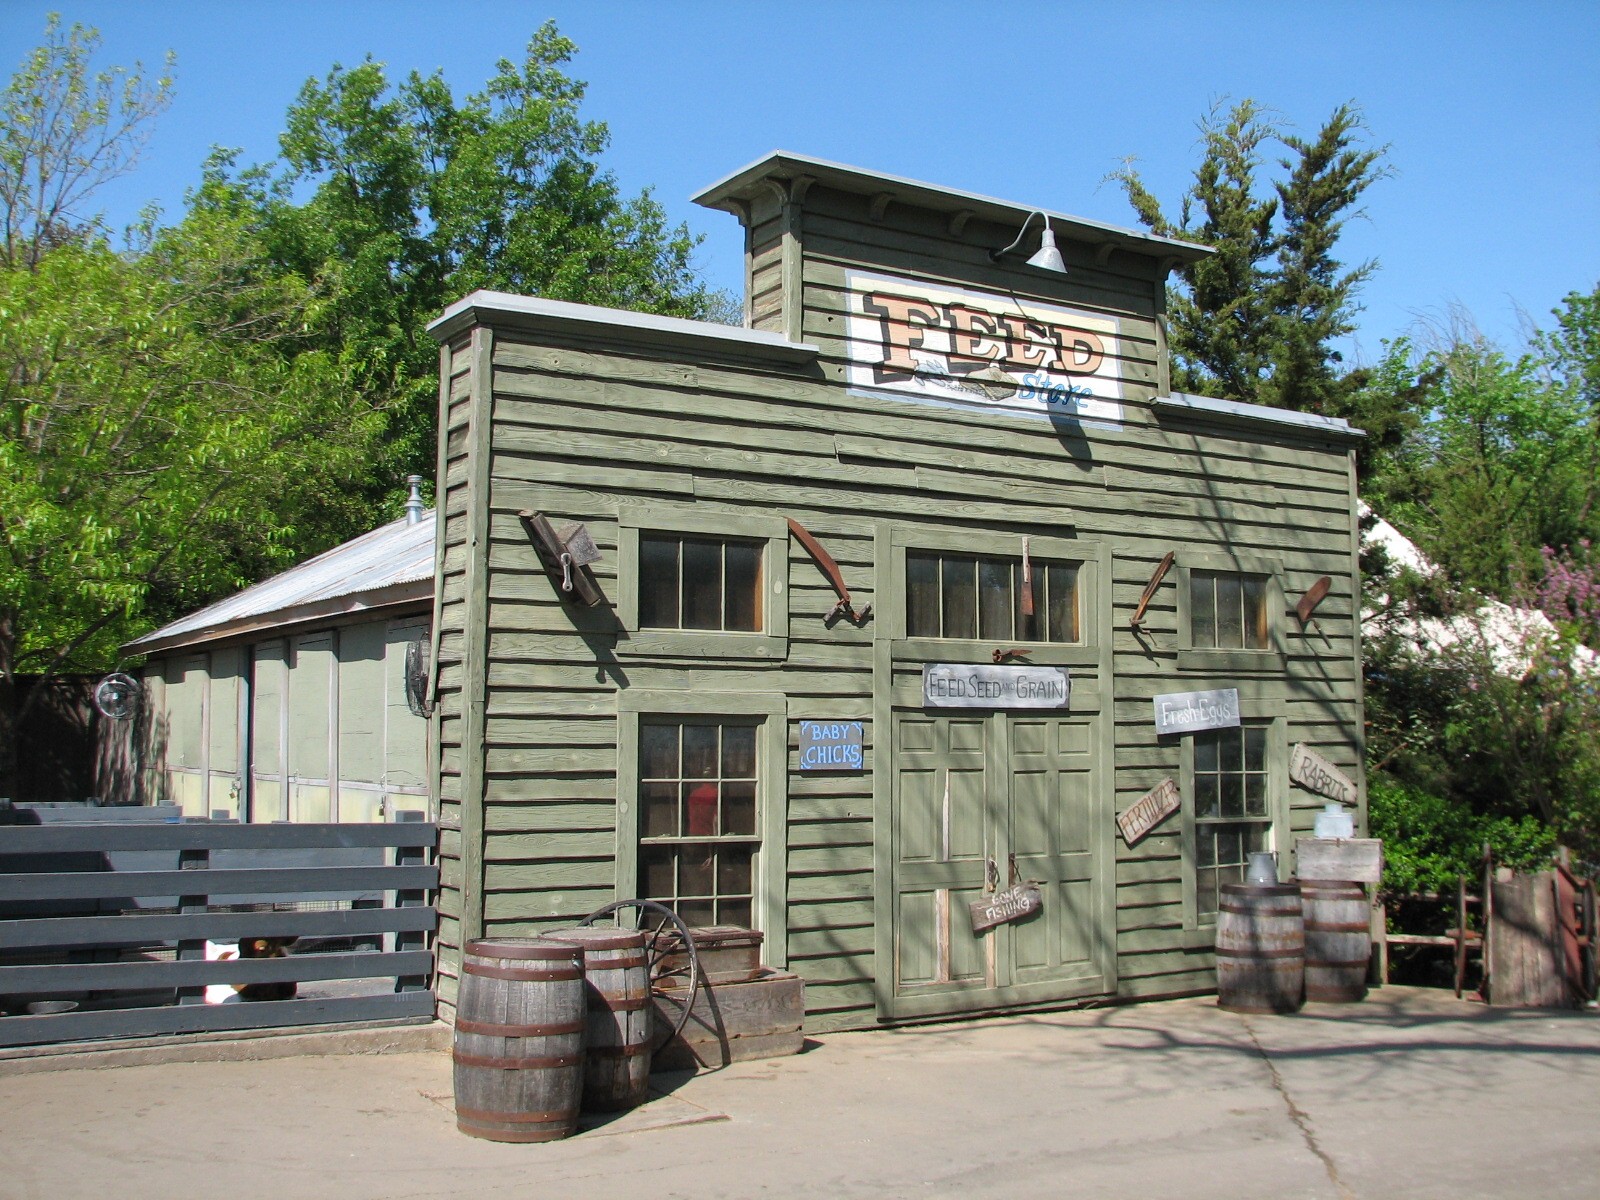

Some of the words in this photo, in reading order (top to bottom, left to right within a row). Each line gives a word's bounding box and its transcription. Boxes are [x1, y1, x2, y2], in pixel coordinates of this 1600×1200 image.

[863, 291, 1105, 384] FEED
[1018, 373, 1093, 409] Store
[929, 673, 966, 698] FEED
[968, 674, 1001, 699] SEED
[1016, 675, 1063, 699] GRAIN
[1161, 699, 1197, 726] Fresh
[1199, 698, 1231, 726] Eggs
[811, 724, 850, 741] BABY
[805, 744, 859, 764] CHICKS
[1119, 780, 1178, 840] FERTILIZER
[985, 896, 1031, 921] FISHING
[991, 886, 1022, 905] GONE
